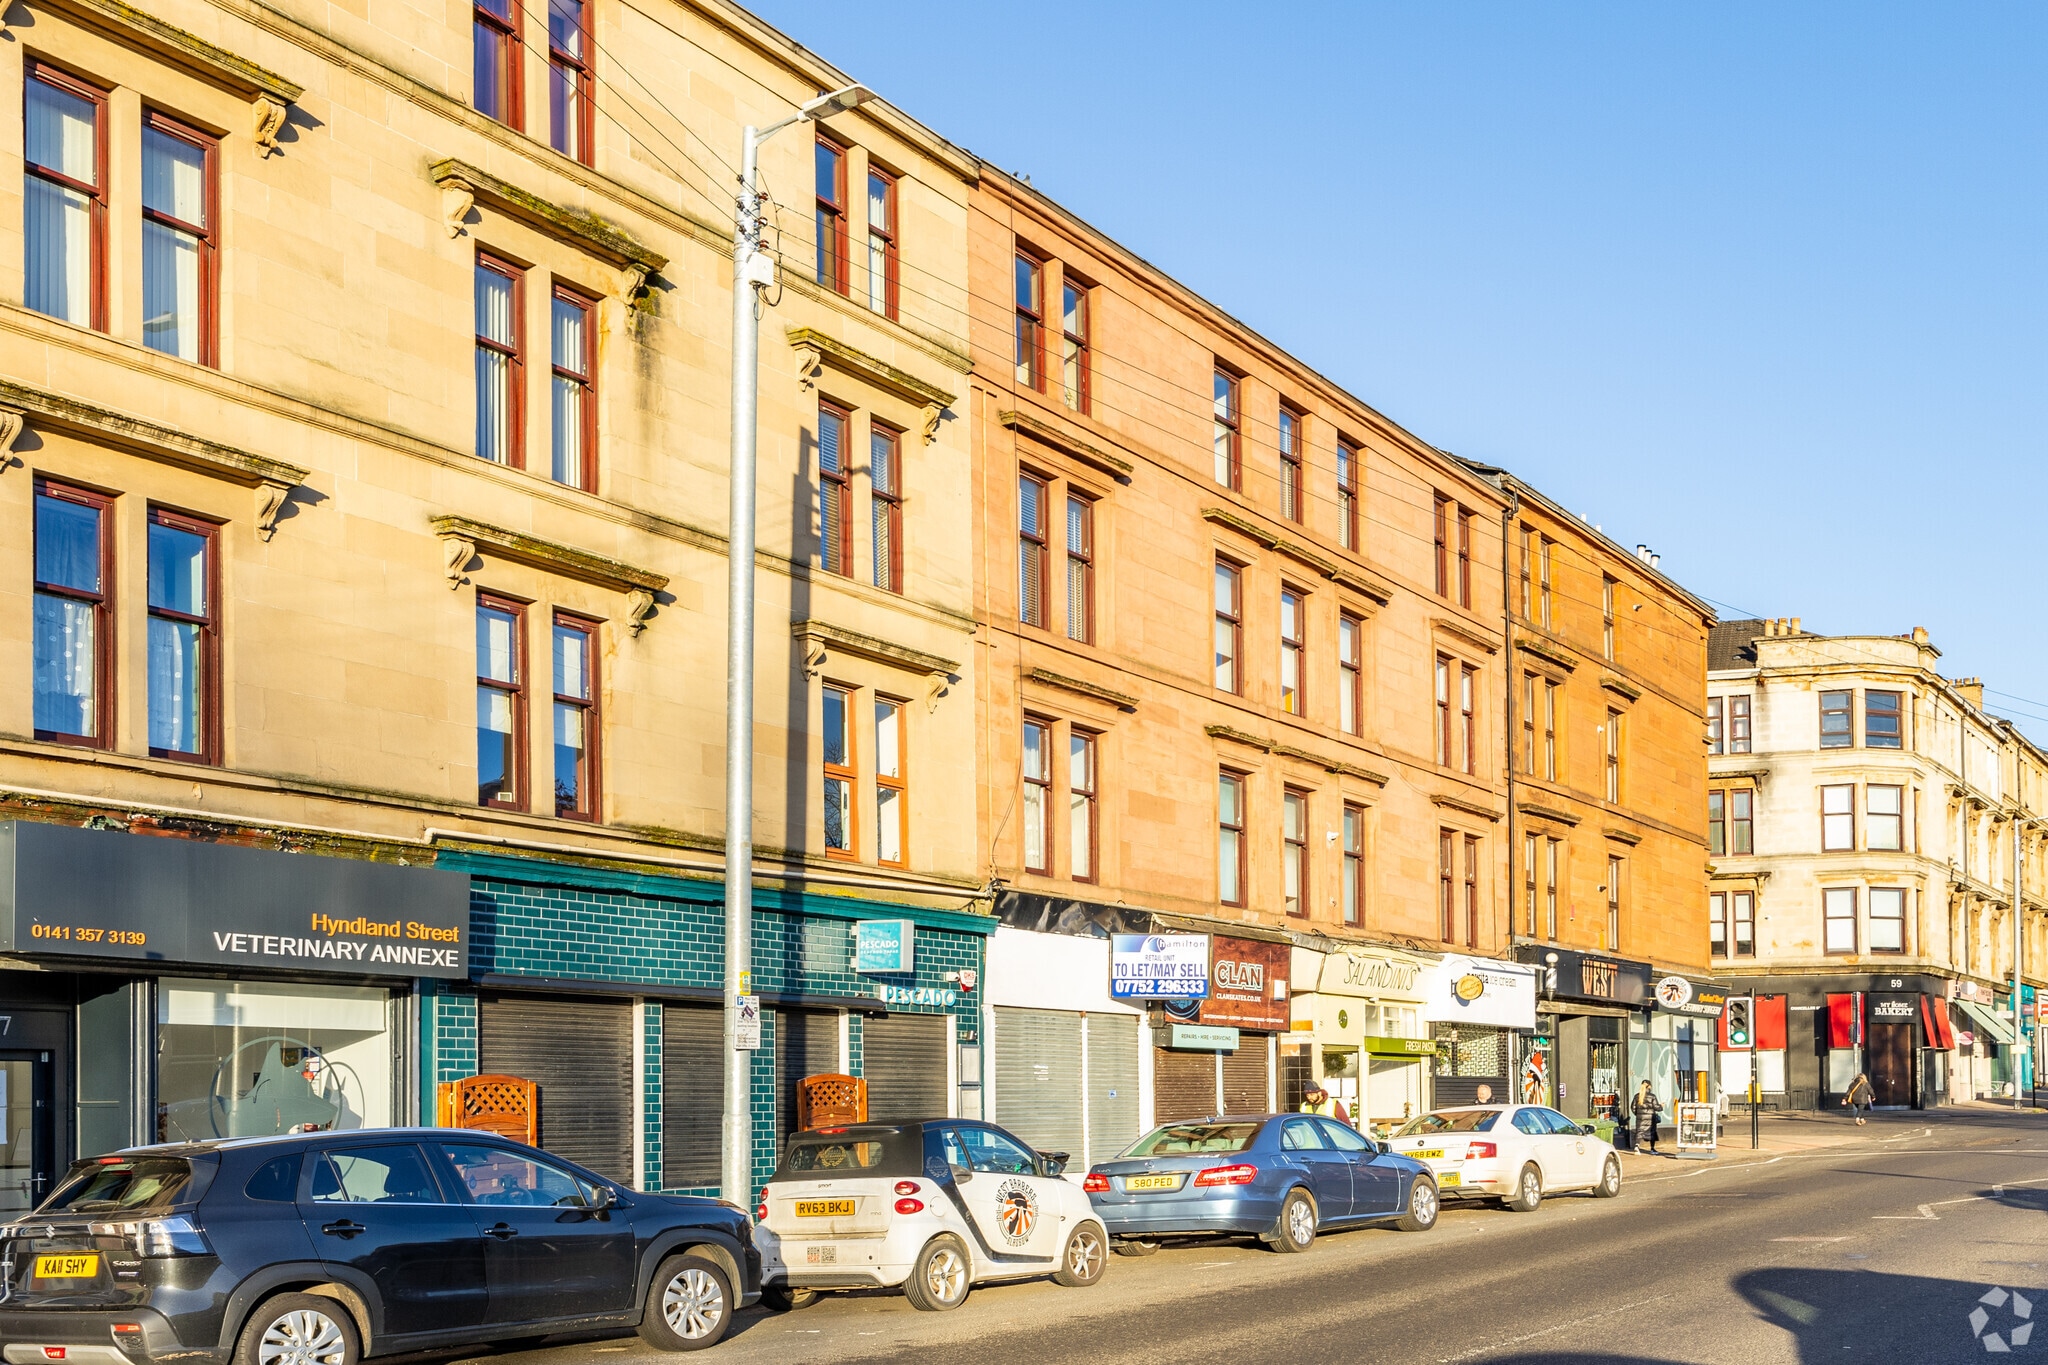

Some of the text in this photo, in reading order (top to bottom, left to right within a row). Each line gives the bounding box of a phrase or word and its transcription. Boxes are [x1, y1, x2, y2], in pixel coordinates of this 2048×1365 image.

[31, 924, 147, 945] 0141 357 3139
[311, 913, 460, 943] Hyndland Street
[213, 931, 460, 968] VETERINARY ANNEXE
[860, 940, 899, 949] PESCADO
[1157, 936, 1206, 951] hamilton
[1115, 963, 1206, 977] TO LET/MAY SELL
[1215, 960, 1263, 991] CLAN
[1582, 959, 1618, 998] WEST
[1890, 979, 1903, 988] 59
[1115, 979, 1205, 994] 07752 296333
[886, 984, 957, 1007] PESCADO
[1874, 1007, 1914, 1016] BAKERY
[1405, 1040, 1436, 1053] FRESH PASTA
[1154, 1178, 1173, 1187] PED
[799, 1201, 850, 1214] RV63 BKJ
[65, 1258, 88, 1274] SHY
